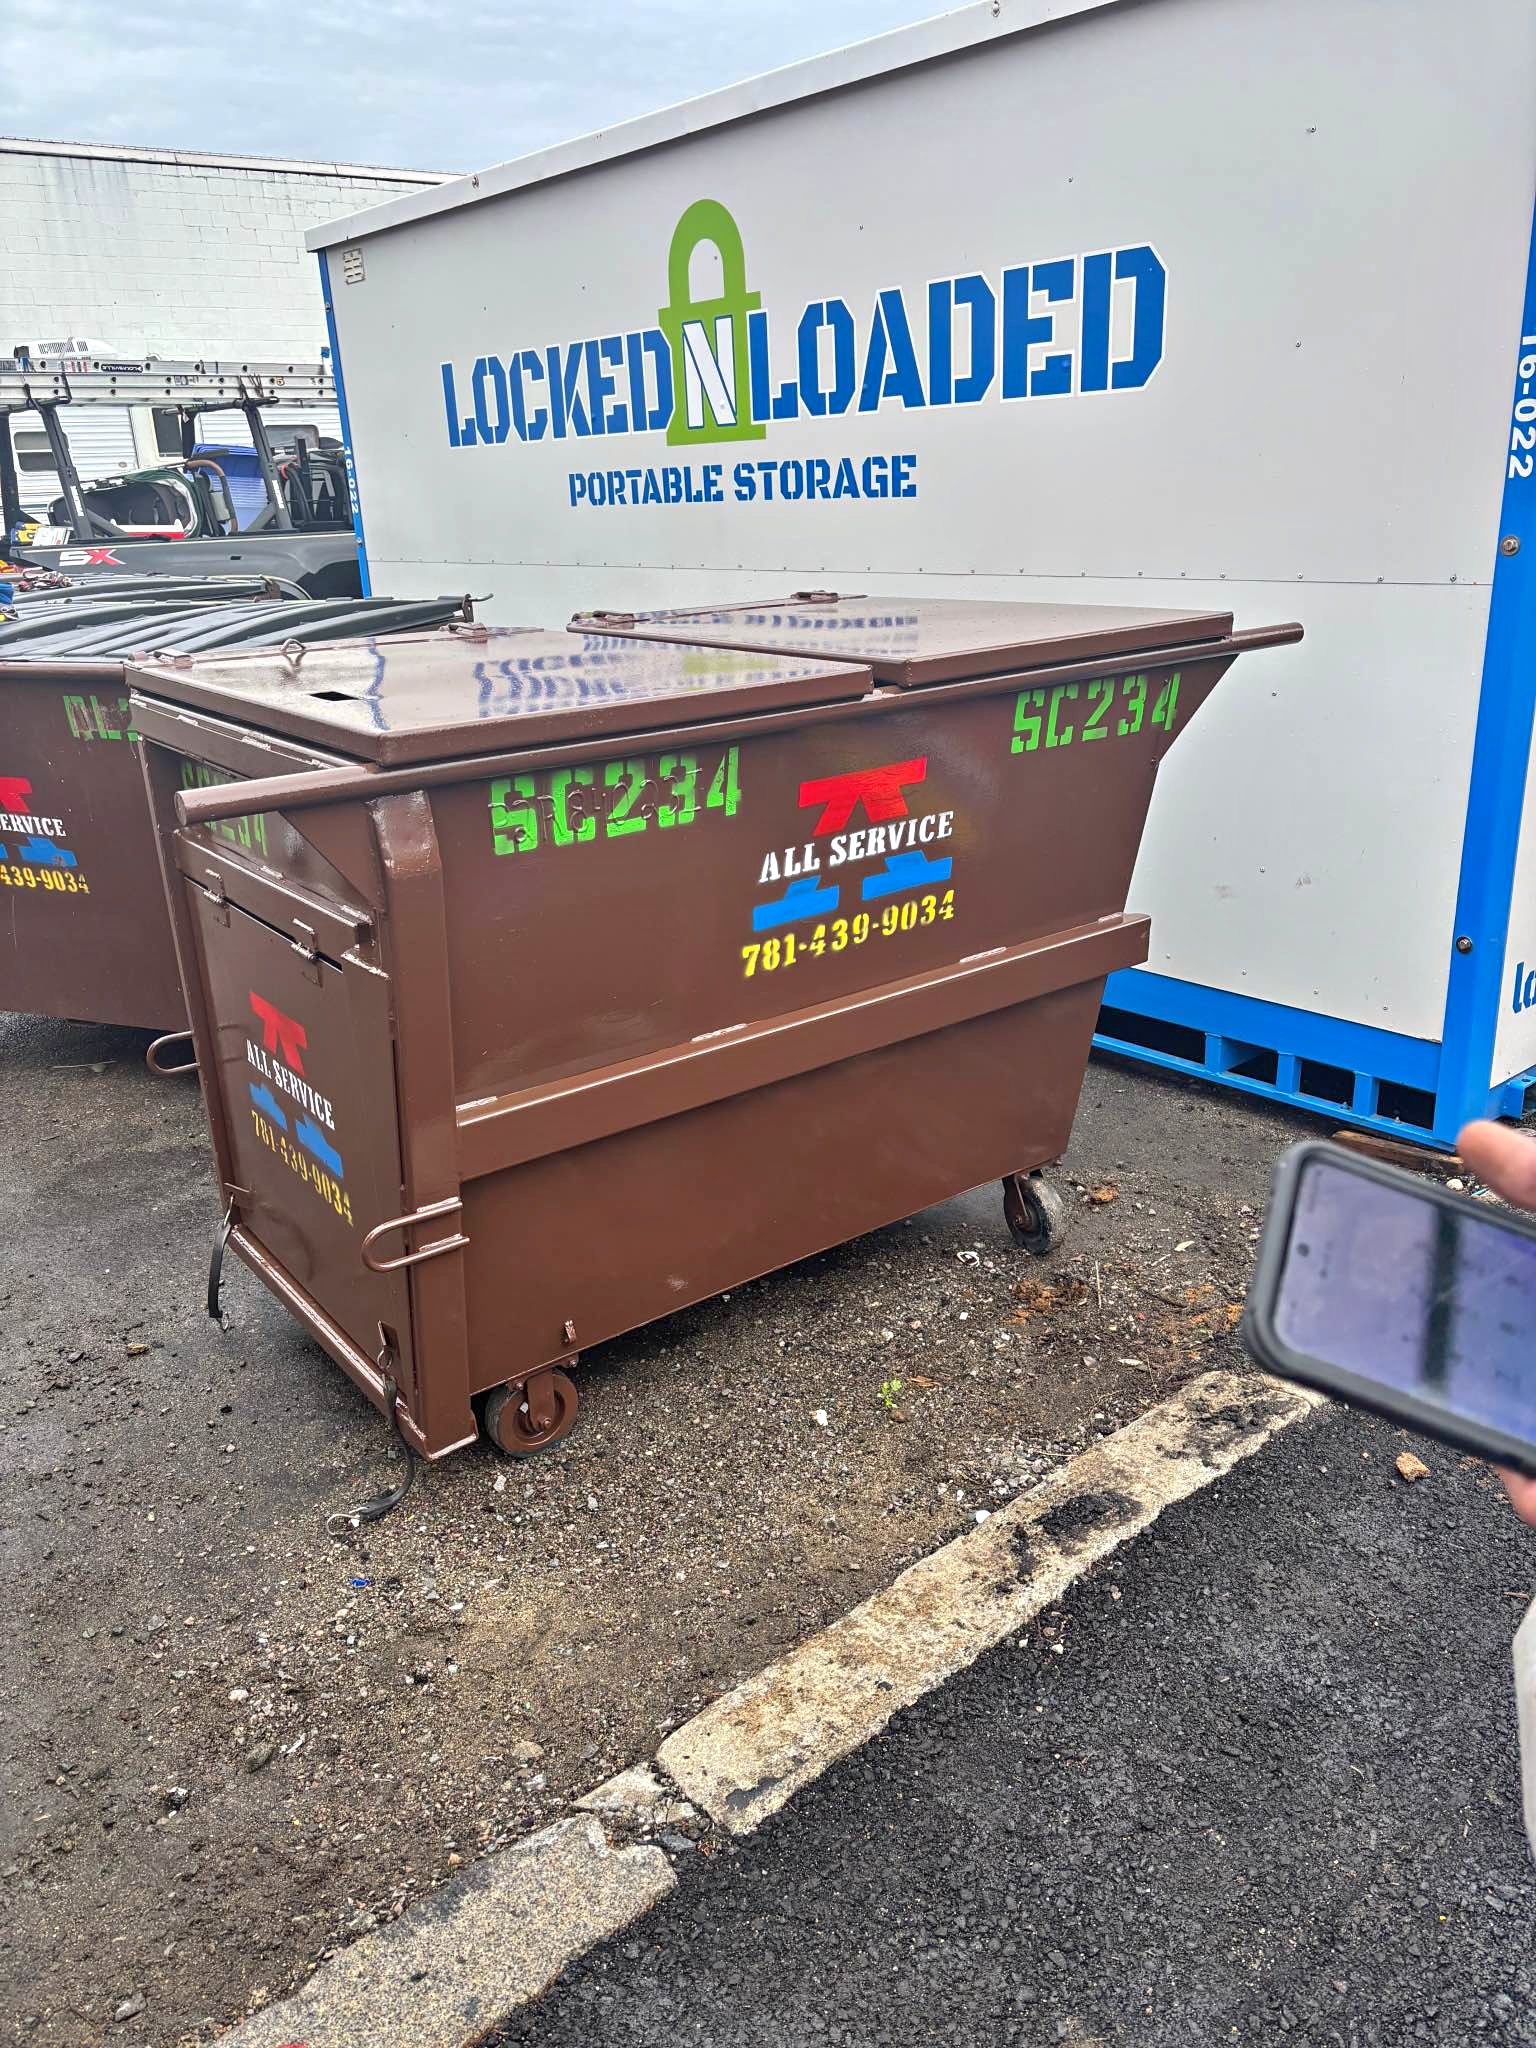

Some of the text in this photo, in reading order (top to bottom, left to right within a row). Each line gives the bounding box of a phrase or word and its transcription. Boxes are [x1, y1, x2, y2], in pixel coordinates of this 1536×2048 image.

[440, 241, 1169, 448] LOCKED N LOADED
[344, 446, 359, 514] 16-022
[568, 454, 917, 507] PORTABLE STORAGE
[1010, 672, 1182, 754] SC234
[0, 813, 67, 837] ERVICE
[490, 745, 742, 856] SC234
[758, 810, 954, 883] ALL SERVICE
[741, 889, 955, 978] 781-439-9034
[246, 1039, 336, 1131] ALL SERVICE
[250, 1109, 354, 1228] 781-439-9034
